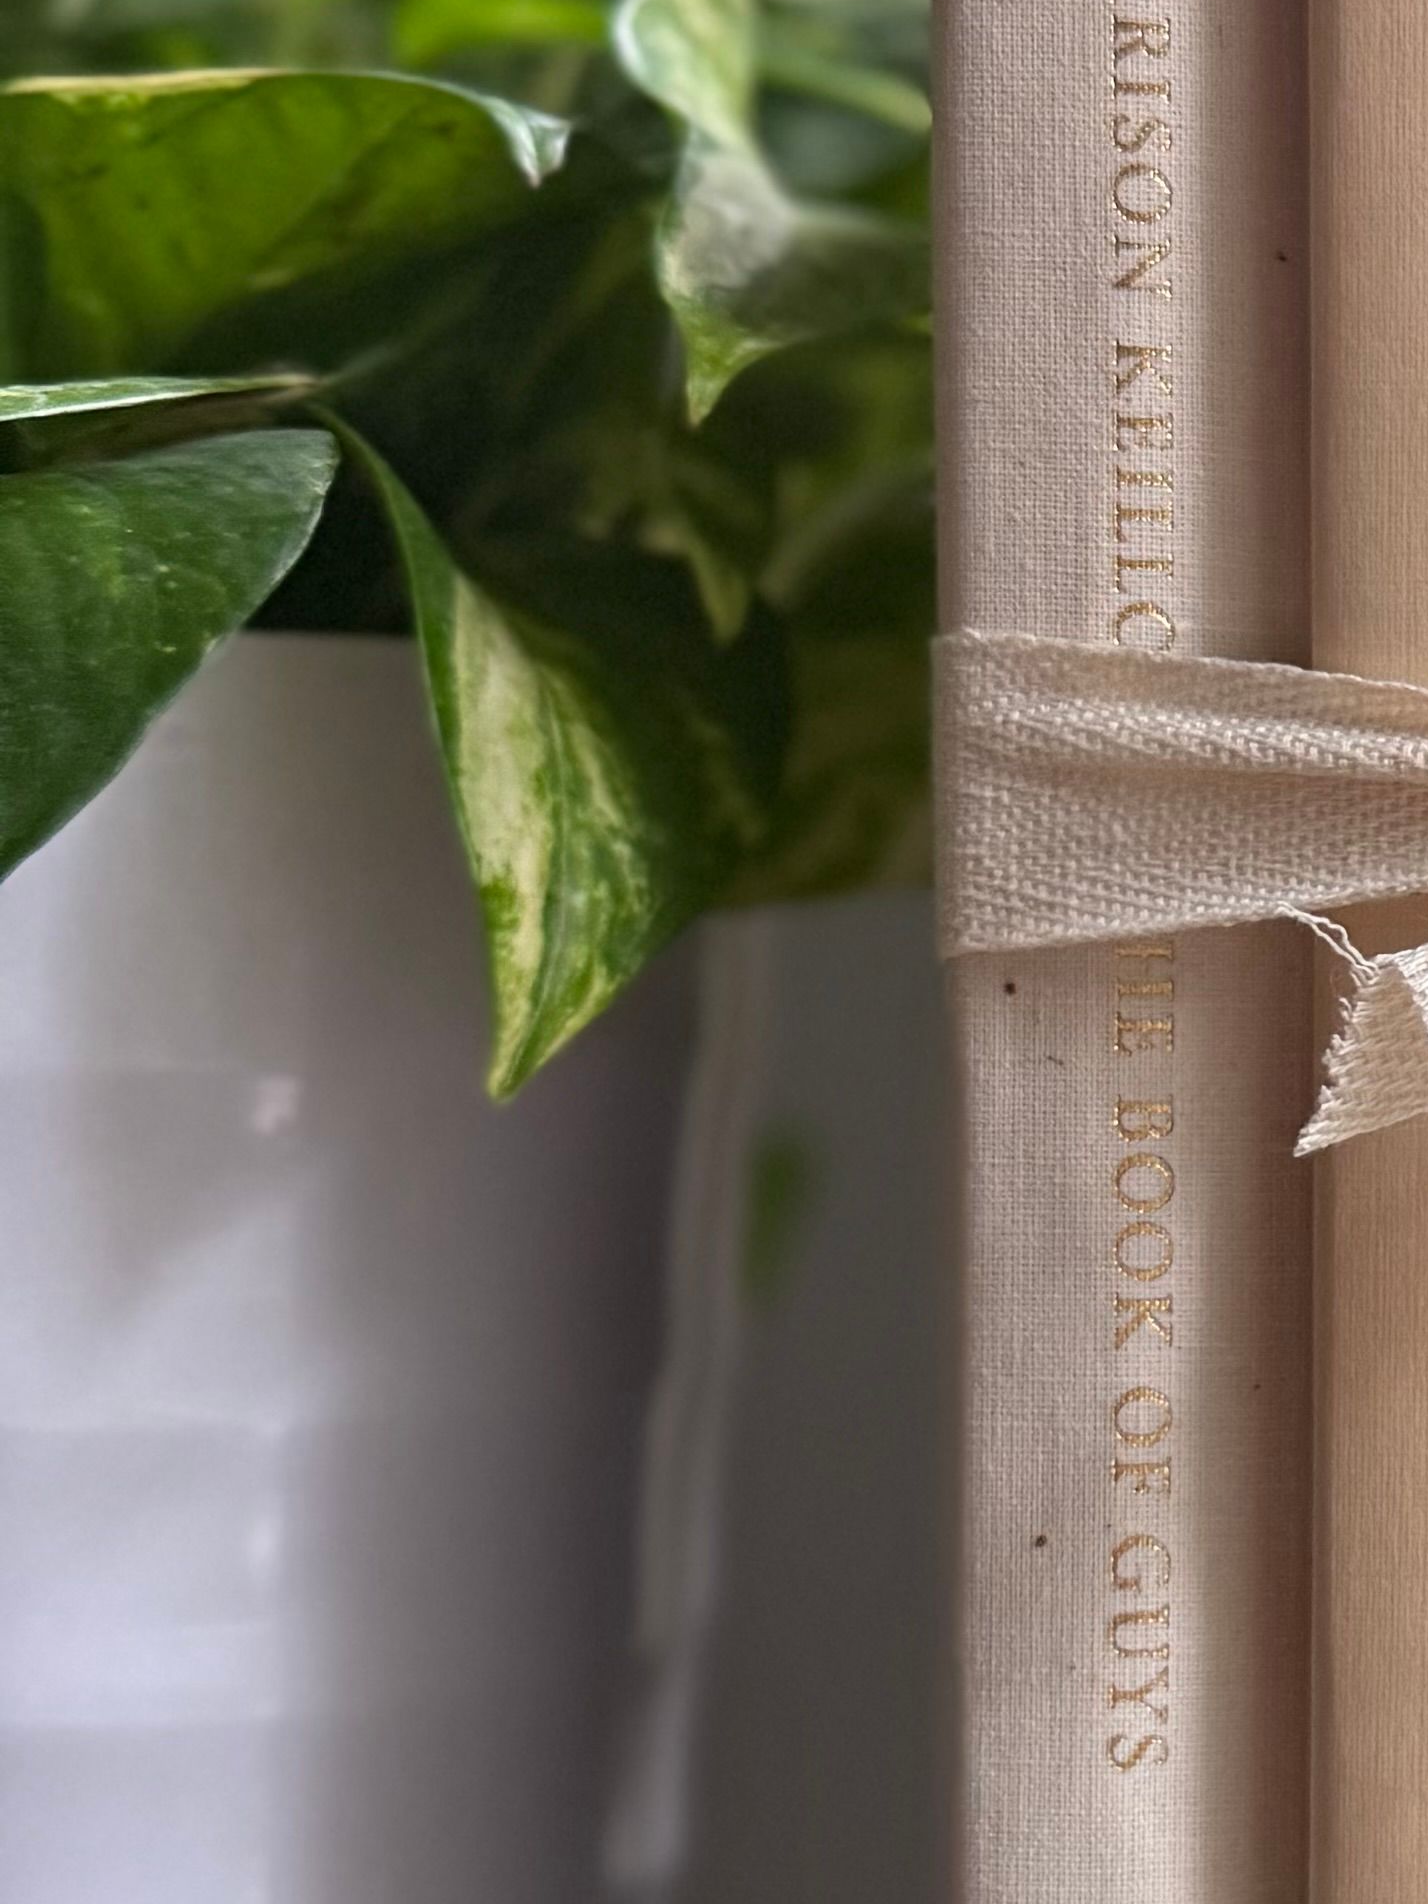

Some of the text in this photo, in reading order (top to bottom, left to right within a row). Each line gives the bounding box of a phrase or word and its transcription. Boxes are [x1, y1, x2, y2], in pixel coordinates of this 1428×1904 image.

[1110, 336, 1177, 649] KEILLO
[1103, 939, 1176, 1773] HE BOOK OF GUYS
